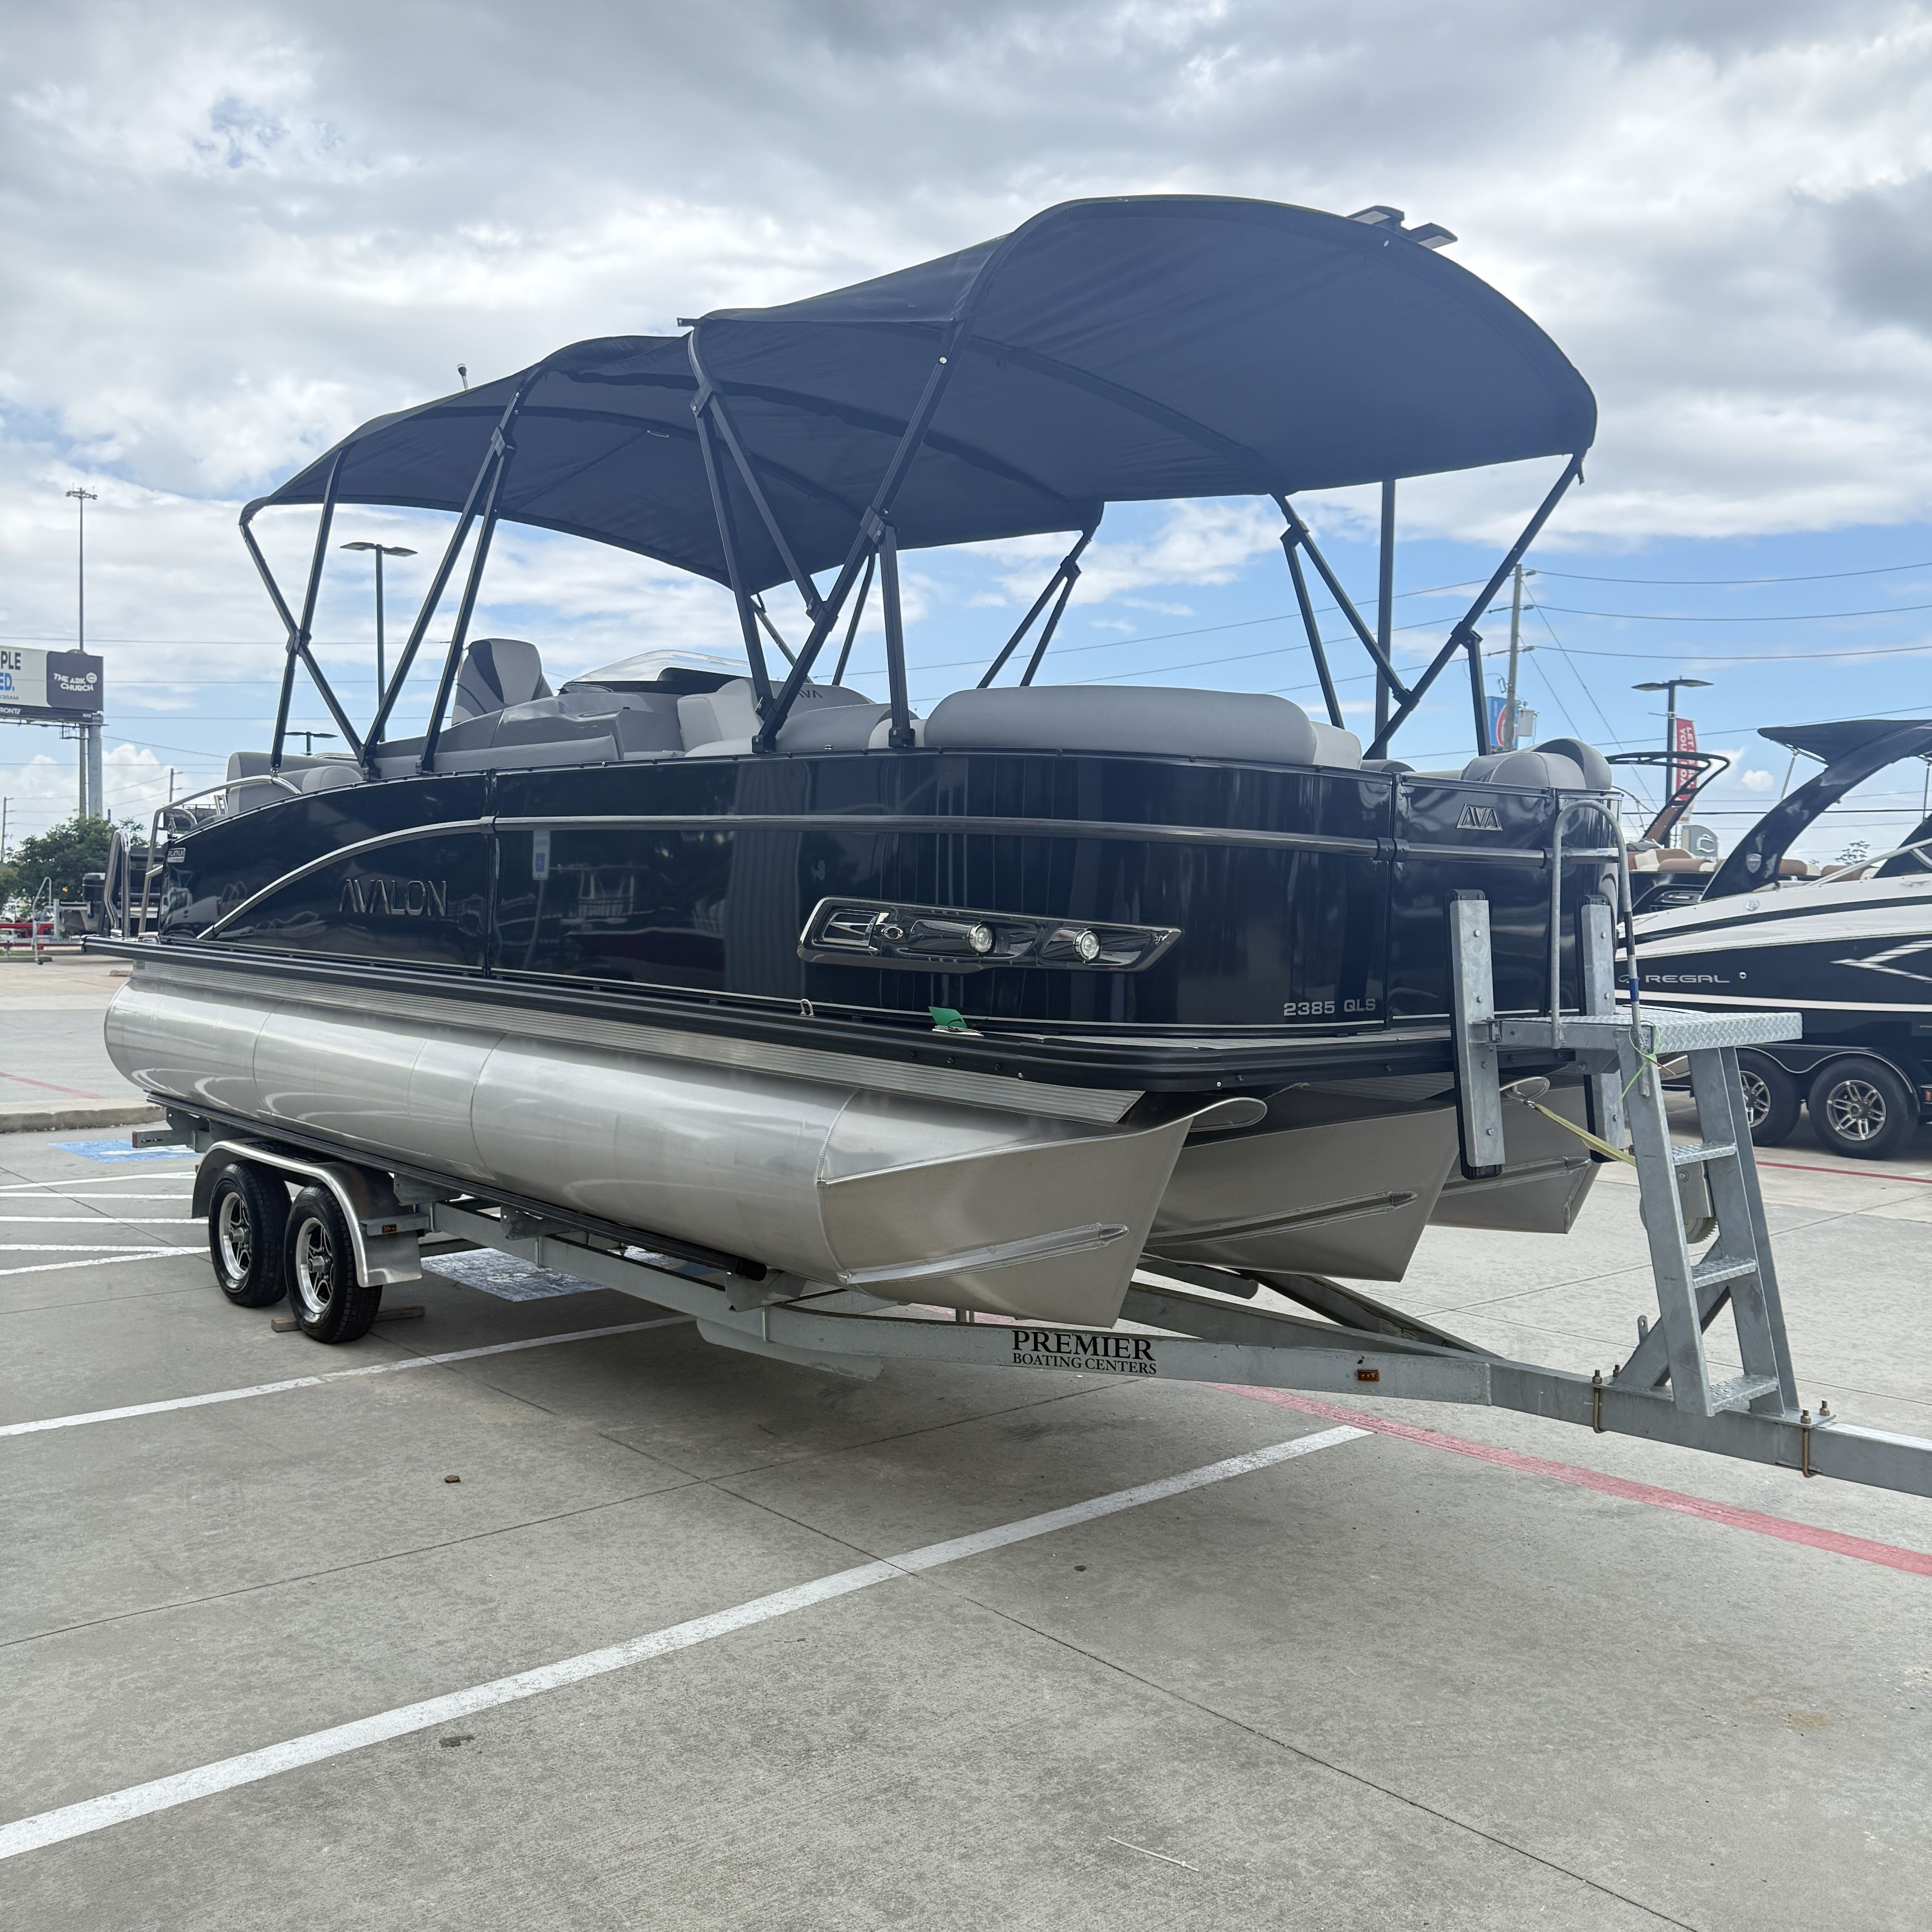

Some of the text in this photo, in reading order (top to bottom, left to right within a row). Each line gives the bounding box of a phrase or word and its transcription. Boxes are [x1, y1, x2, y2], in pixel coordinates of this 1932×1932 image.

[0, 651, 21, 670] PLE
[54, 673, 69, 683] THE
[60, 682, 94, 692] CHURCH
[1679, 728, 1688, 753] YOU
[1687, 727, 1695, 748] LET
[1458, 805, 1501, 829] AVA
[339, 879, 446, 916] AVALON
[1645, 975, 1730, 983] REGAL
[1283, 998, 1375, 1016] 2385 QLS
[1012, 1330, 1156, 1361] PREMIER
[1012, 1353, 1157, 1374] BOATING CENTERS
